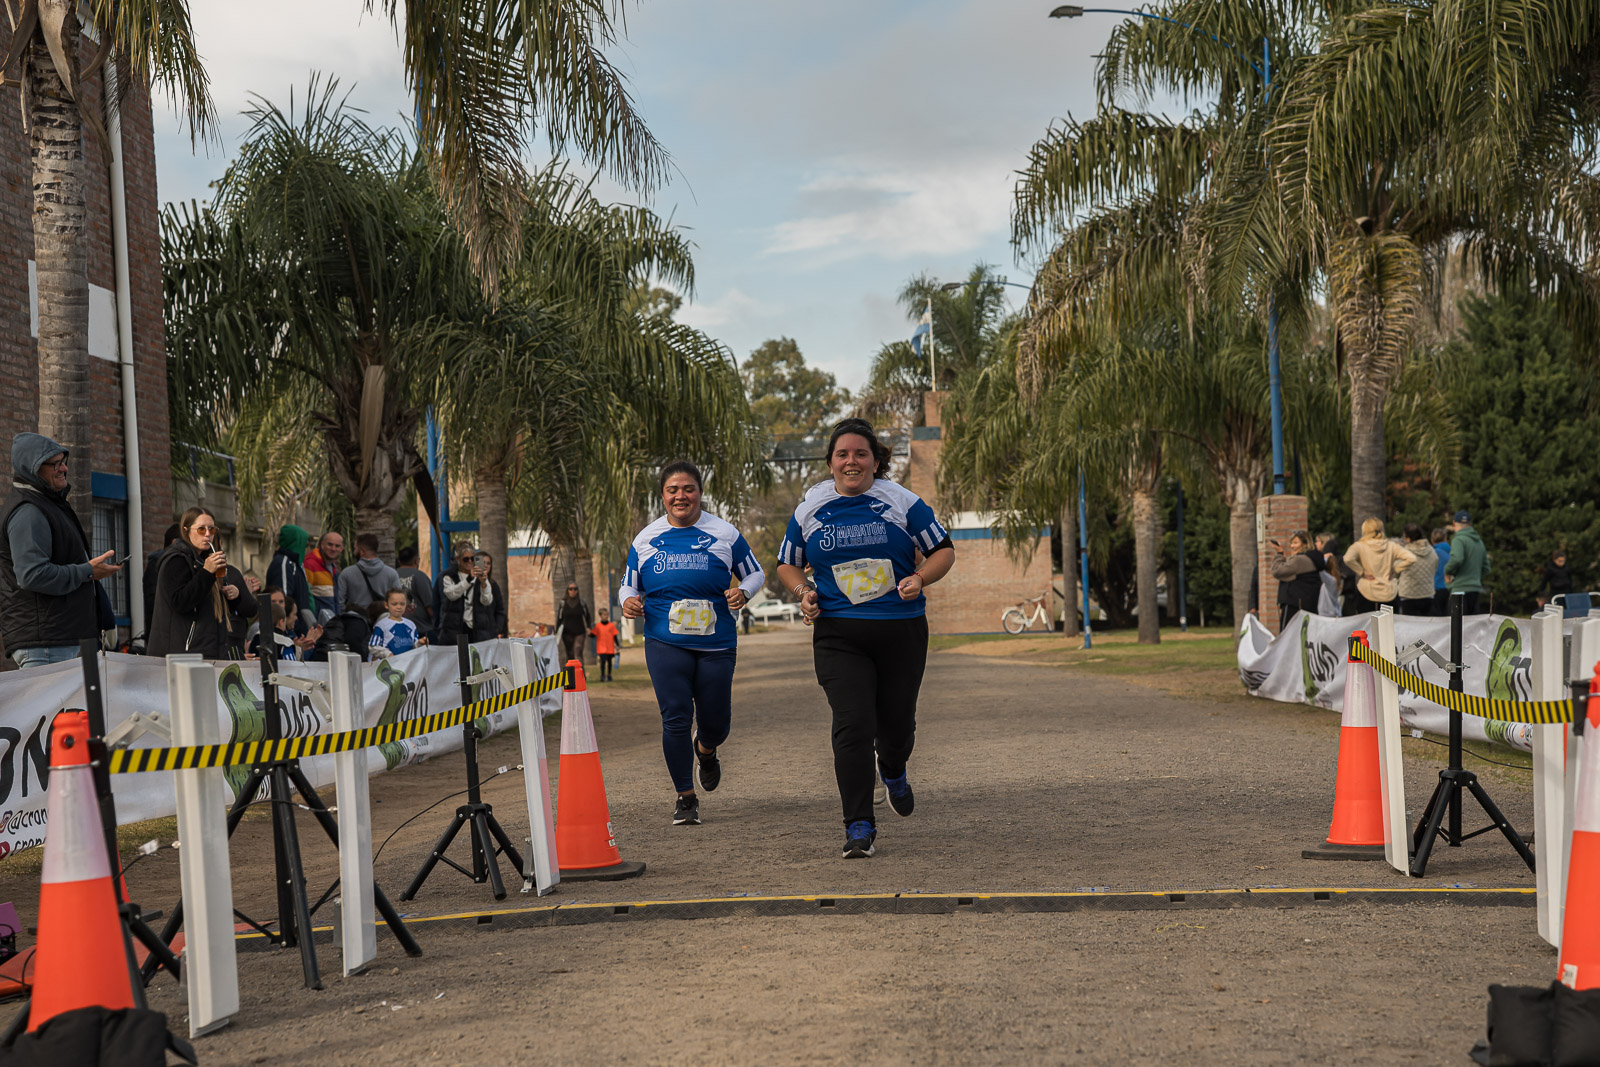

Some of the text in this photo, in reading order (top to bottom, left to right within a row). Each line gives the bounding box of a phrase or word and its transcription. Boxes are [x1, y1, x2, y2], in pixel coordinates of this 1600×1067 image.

[819, 521, 888, 552] 3 MARATÓN
[653, 550, 667, 575] 3
[840, 566, 890, 596] 734
[675, 609, 712, 627] 719
[7, 808, 49, 835] @cron
